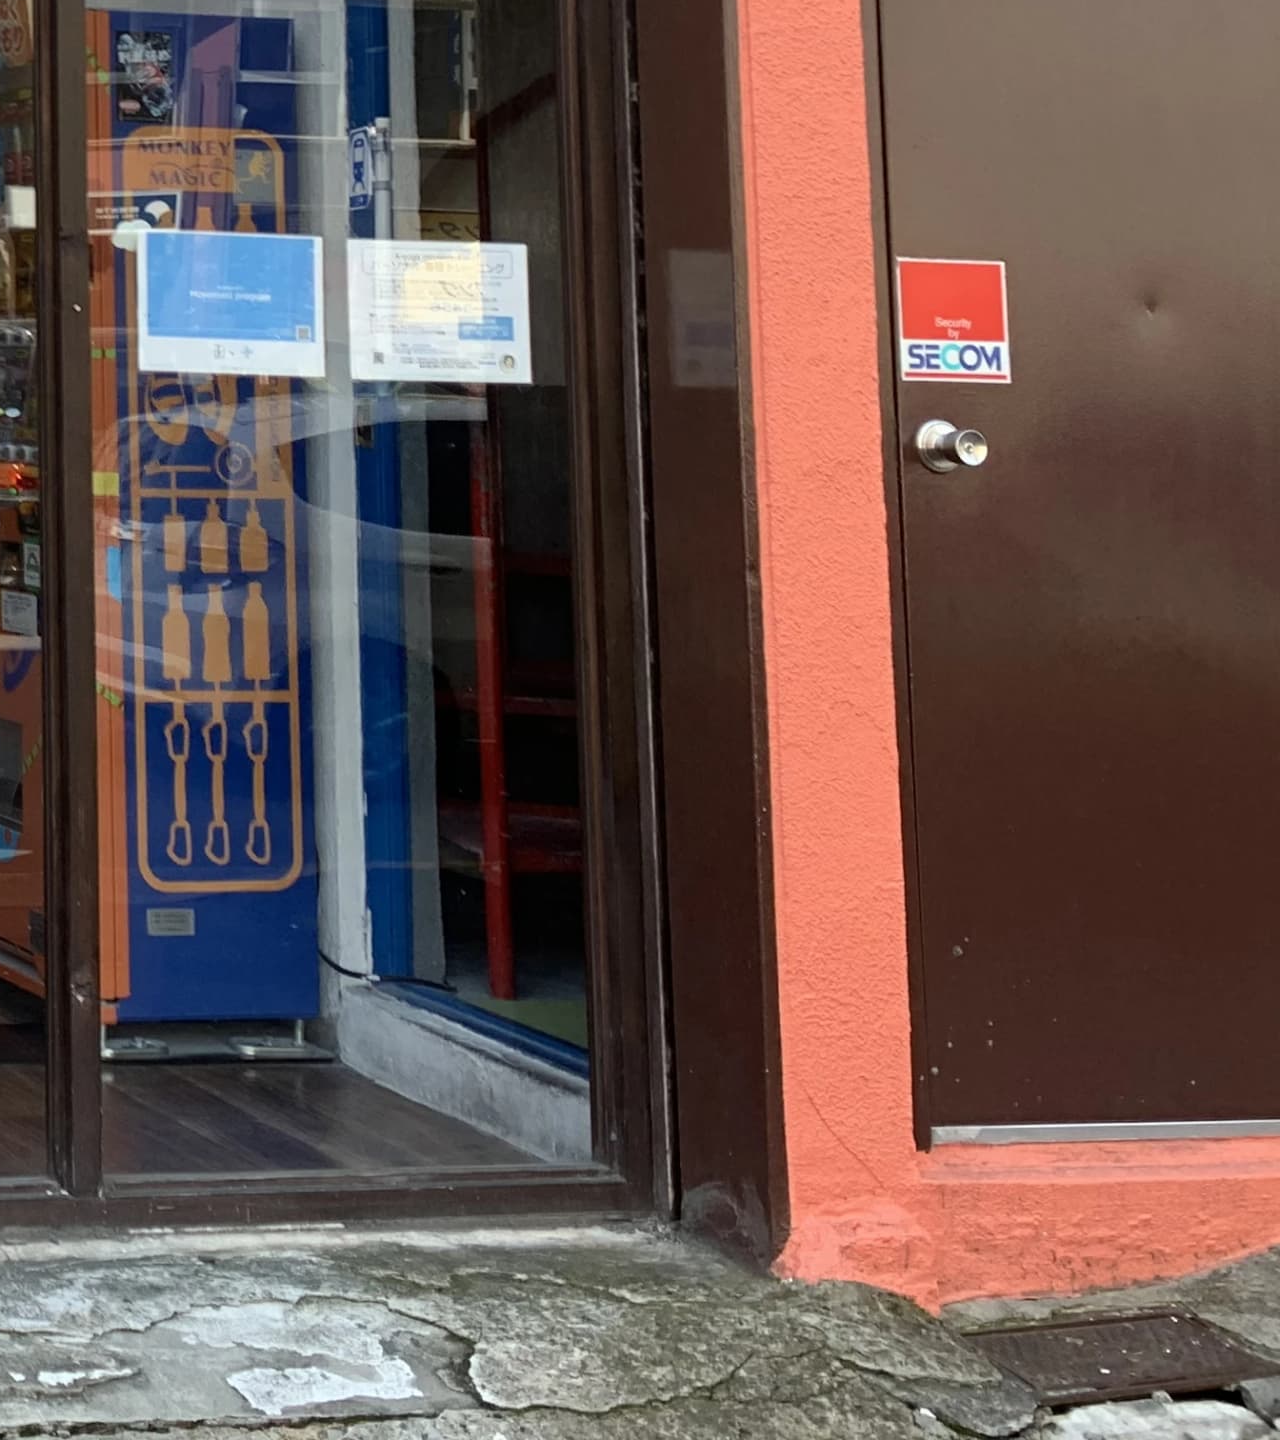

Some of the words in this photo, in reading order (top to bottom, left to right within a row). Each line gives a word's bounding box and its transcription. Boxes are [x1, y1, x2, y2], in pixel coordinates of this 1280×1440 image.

[139, 140, 231, 156] MONKEY
[149, 168, 222, 186] MAGIC
[935, 316, 972, 330] Security
[947, 328, 960, 340] by
[908, 343, 1002, 371] SECOM
